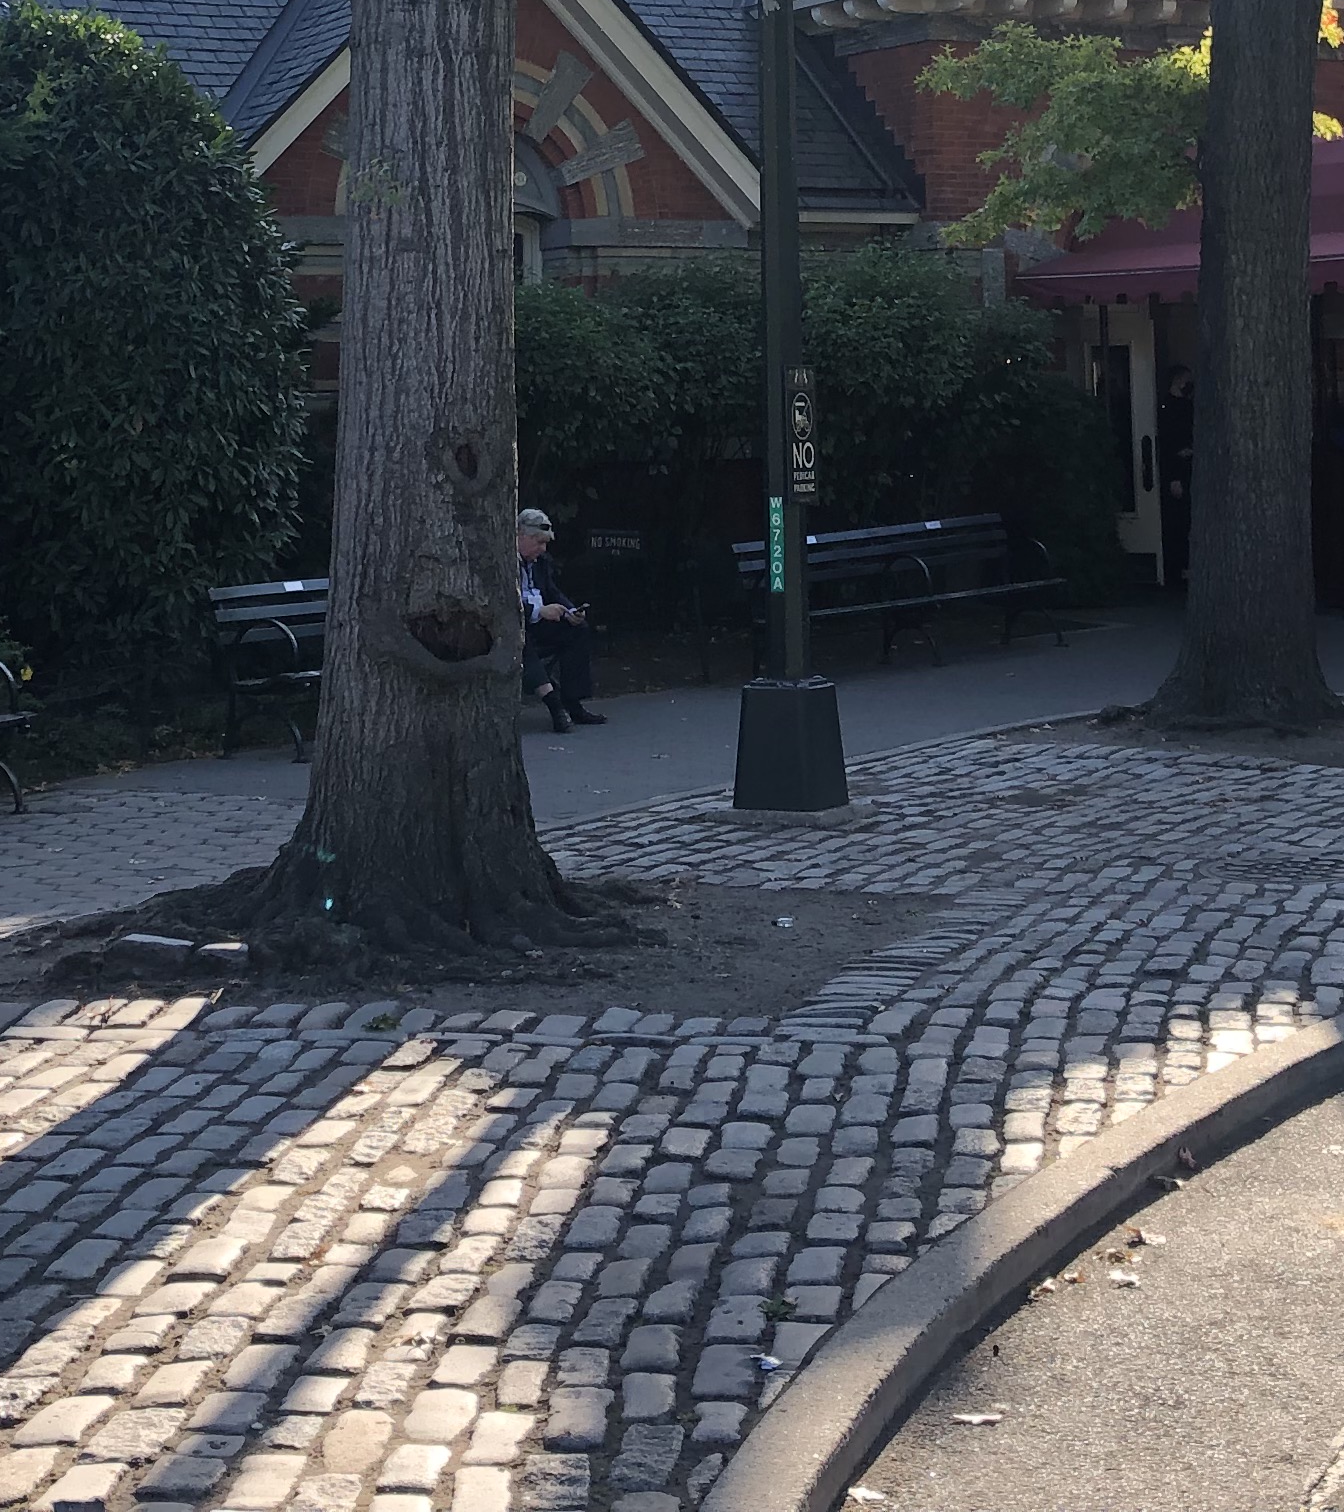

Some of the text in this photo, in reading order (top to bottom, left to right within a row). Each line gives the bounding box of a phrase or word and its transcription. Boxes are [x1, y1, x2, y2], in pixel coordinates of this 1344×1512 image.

[792, 441, 815, 469] NO
[591, 536, 641, 550] NO SMOKING
[769, 496, 783, 590] W6720A
